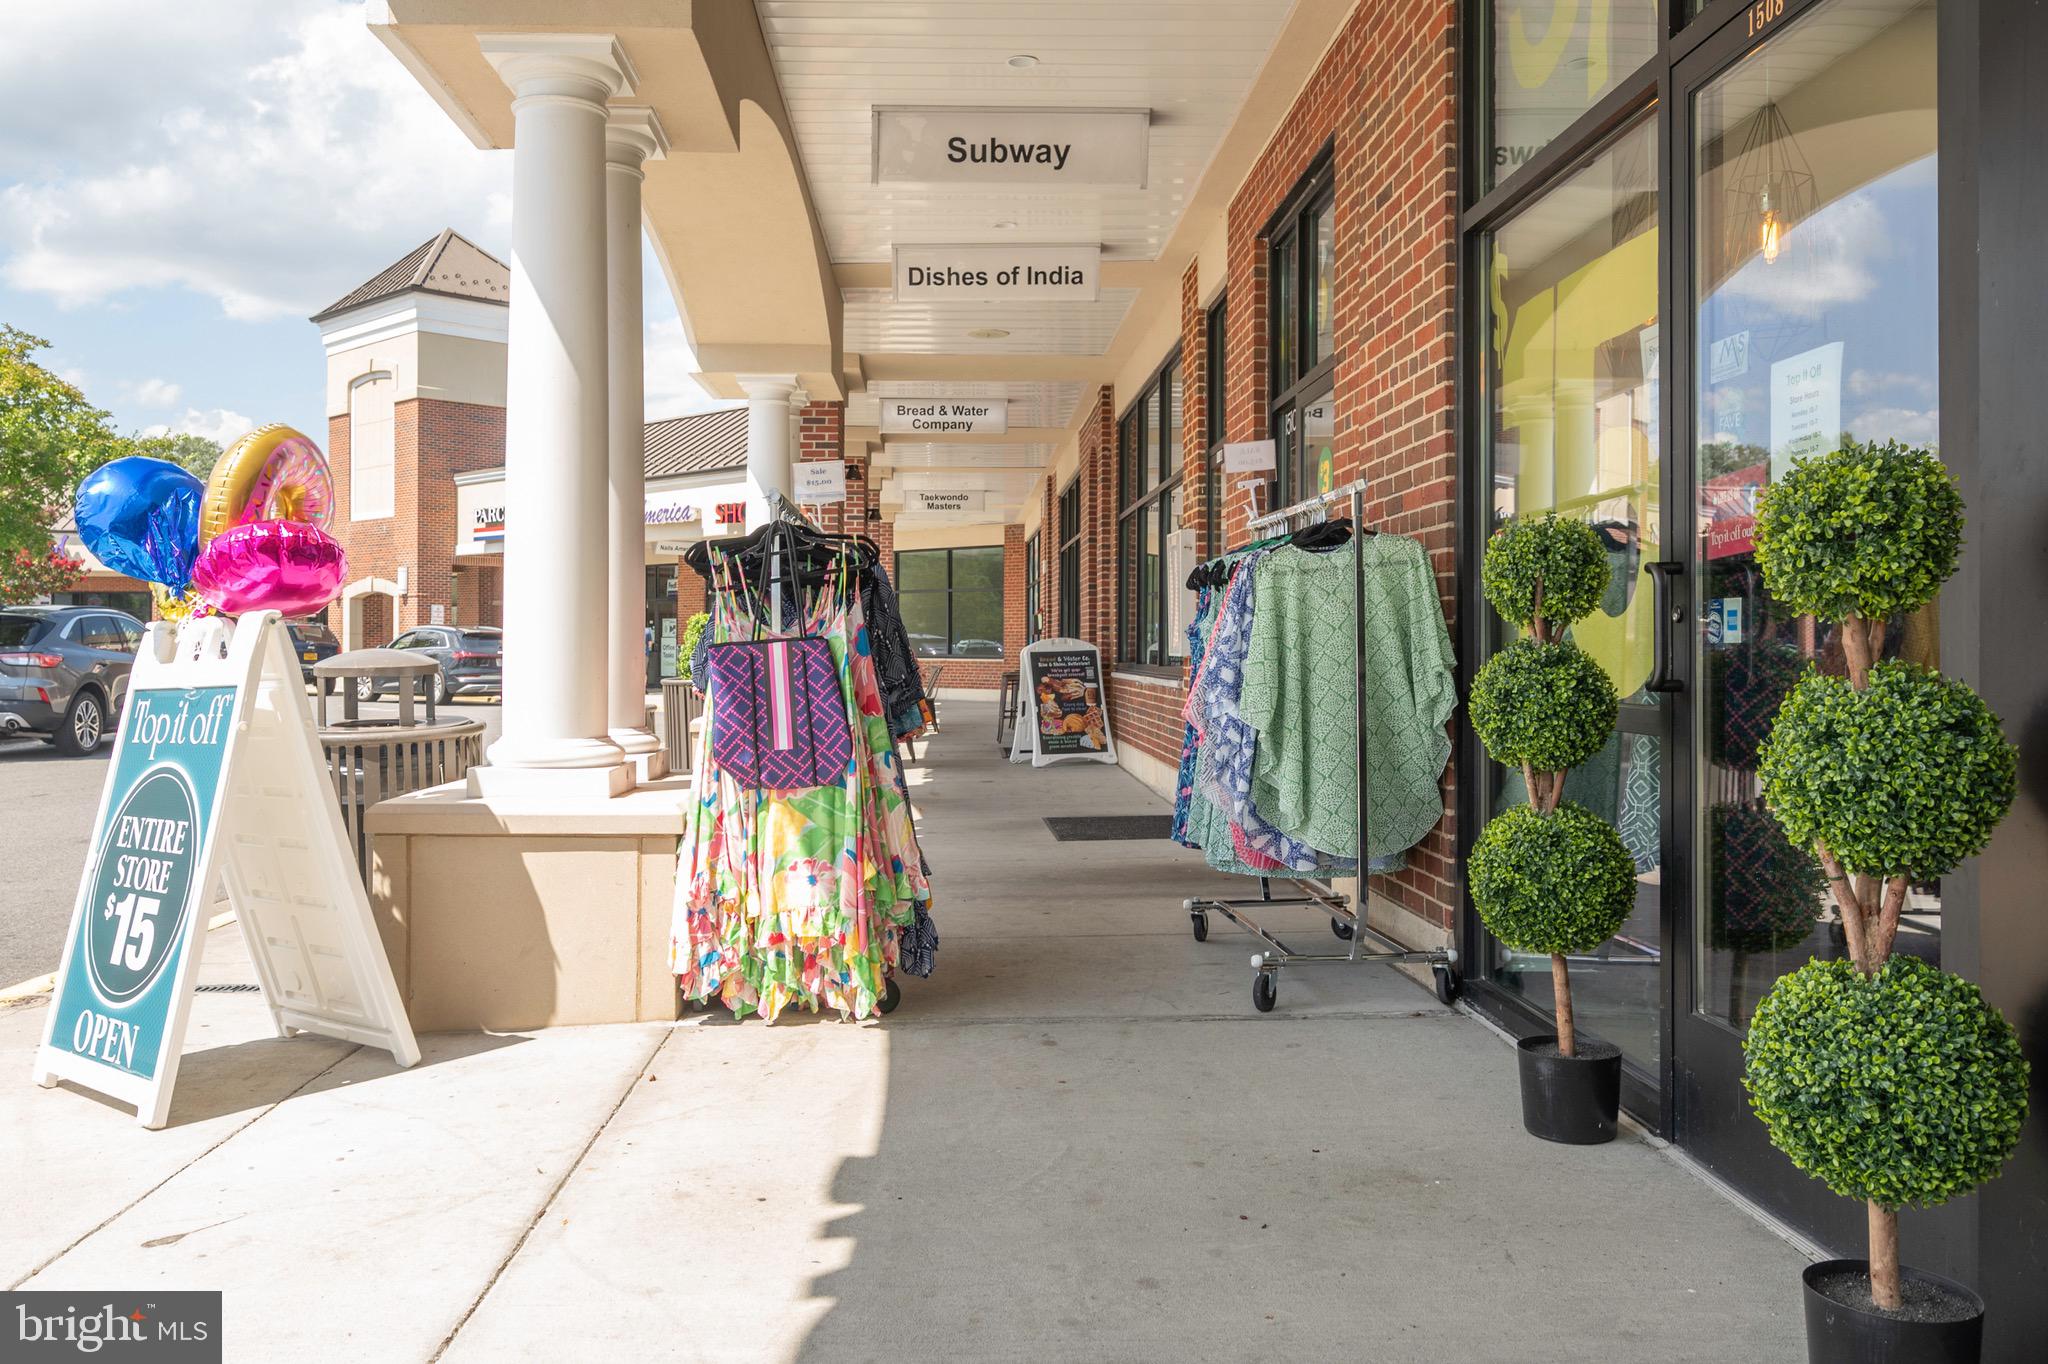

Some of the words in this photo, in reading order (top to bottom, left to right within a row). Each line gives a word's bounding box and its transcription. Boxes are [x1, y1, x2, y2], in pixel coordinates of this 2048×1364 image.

[947, 137, 1071, 170] Subway
[908, 266, 988, 286] Dishes
[996, 266, 1020, 286] of
[1027, 265, 1084, 286] India
[896, 405, 935, 417] Bread
[938, 405, 948, 417] &
[951, 405, 989, 417] Water
[912, 418, 973, 432] Company
[810, 467, 827, 475] Sale
[806, 479, 832, 487] $15.00
[919, 492, 969, 502] Taekwondo
[926, 502, 961, 511] Masters
[474, 506, 505, 524] PARC
[644, 500, 692, 524] merica
[1711, 530, 1724, 549] Top
[131, 698, 171, 761] Top
[169, 699, 190, 745] it
[189, 693, 231, 745] off
[116, 814, 190, 856] ENTIRE
[113, 853, 175, 895] STORE
[103, 892, 160, 972] $15
[72, 1008, 141, 1069] OPEN
